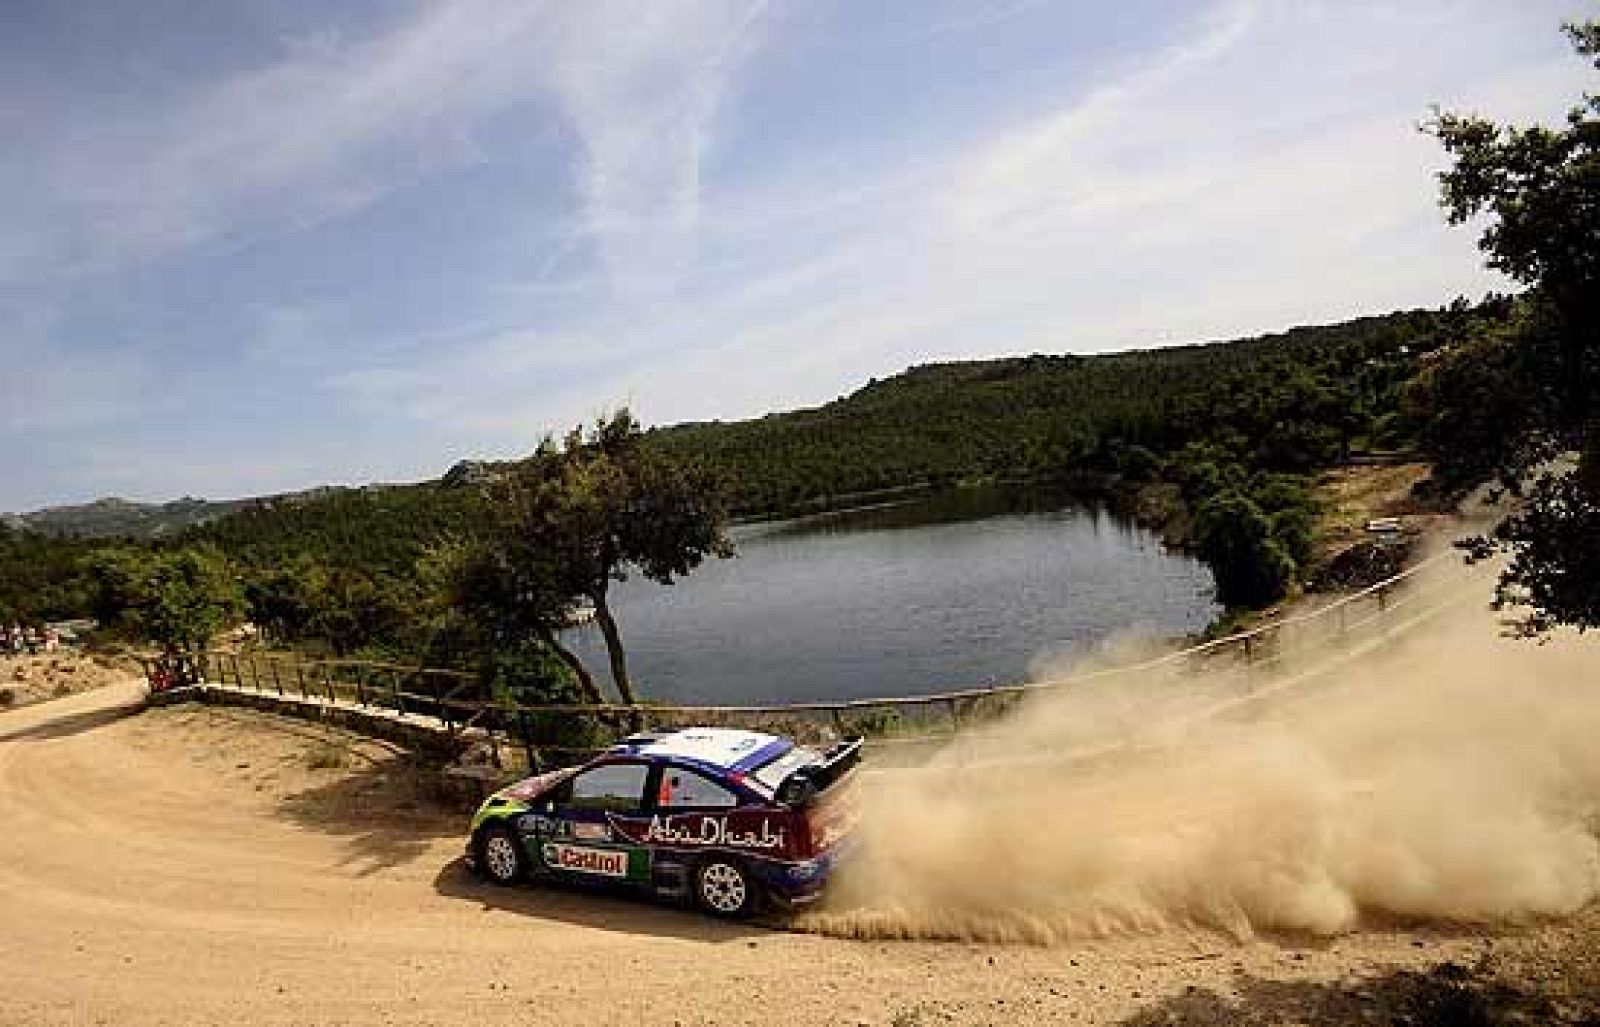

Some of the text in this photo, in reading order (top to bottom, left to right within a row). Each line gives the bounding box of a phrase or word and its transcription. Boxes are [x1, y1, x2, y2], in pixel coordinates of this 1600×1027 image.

[643, 814, 784, 848] Abu Dhabi
[560, 848, 622, 874] Castrol
